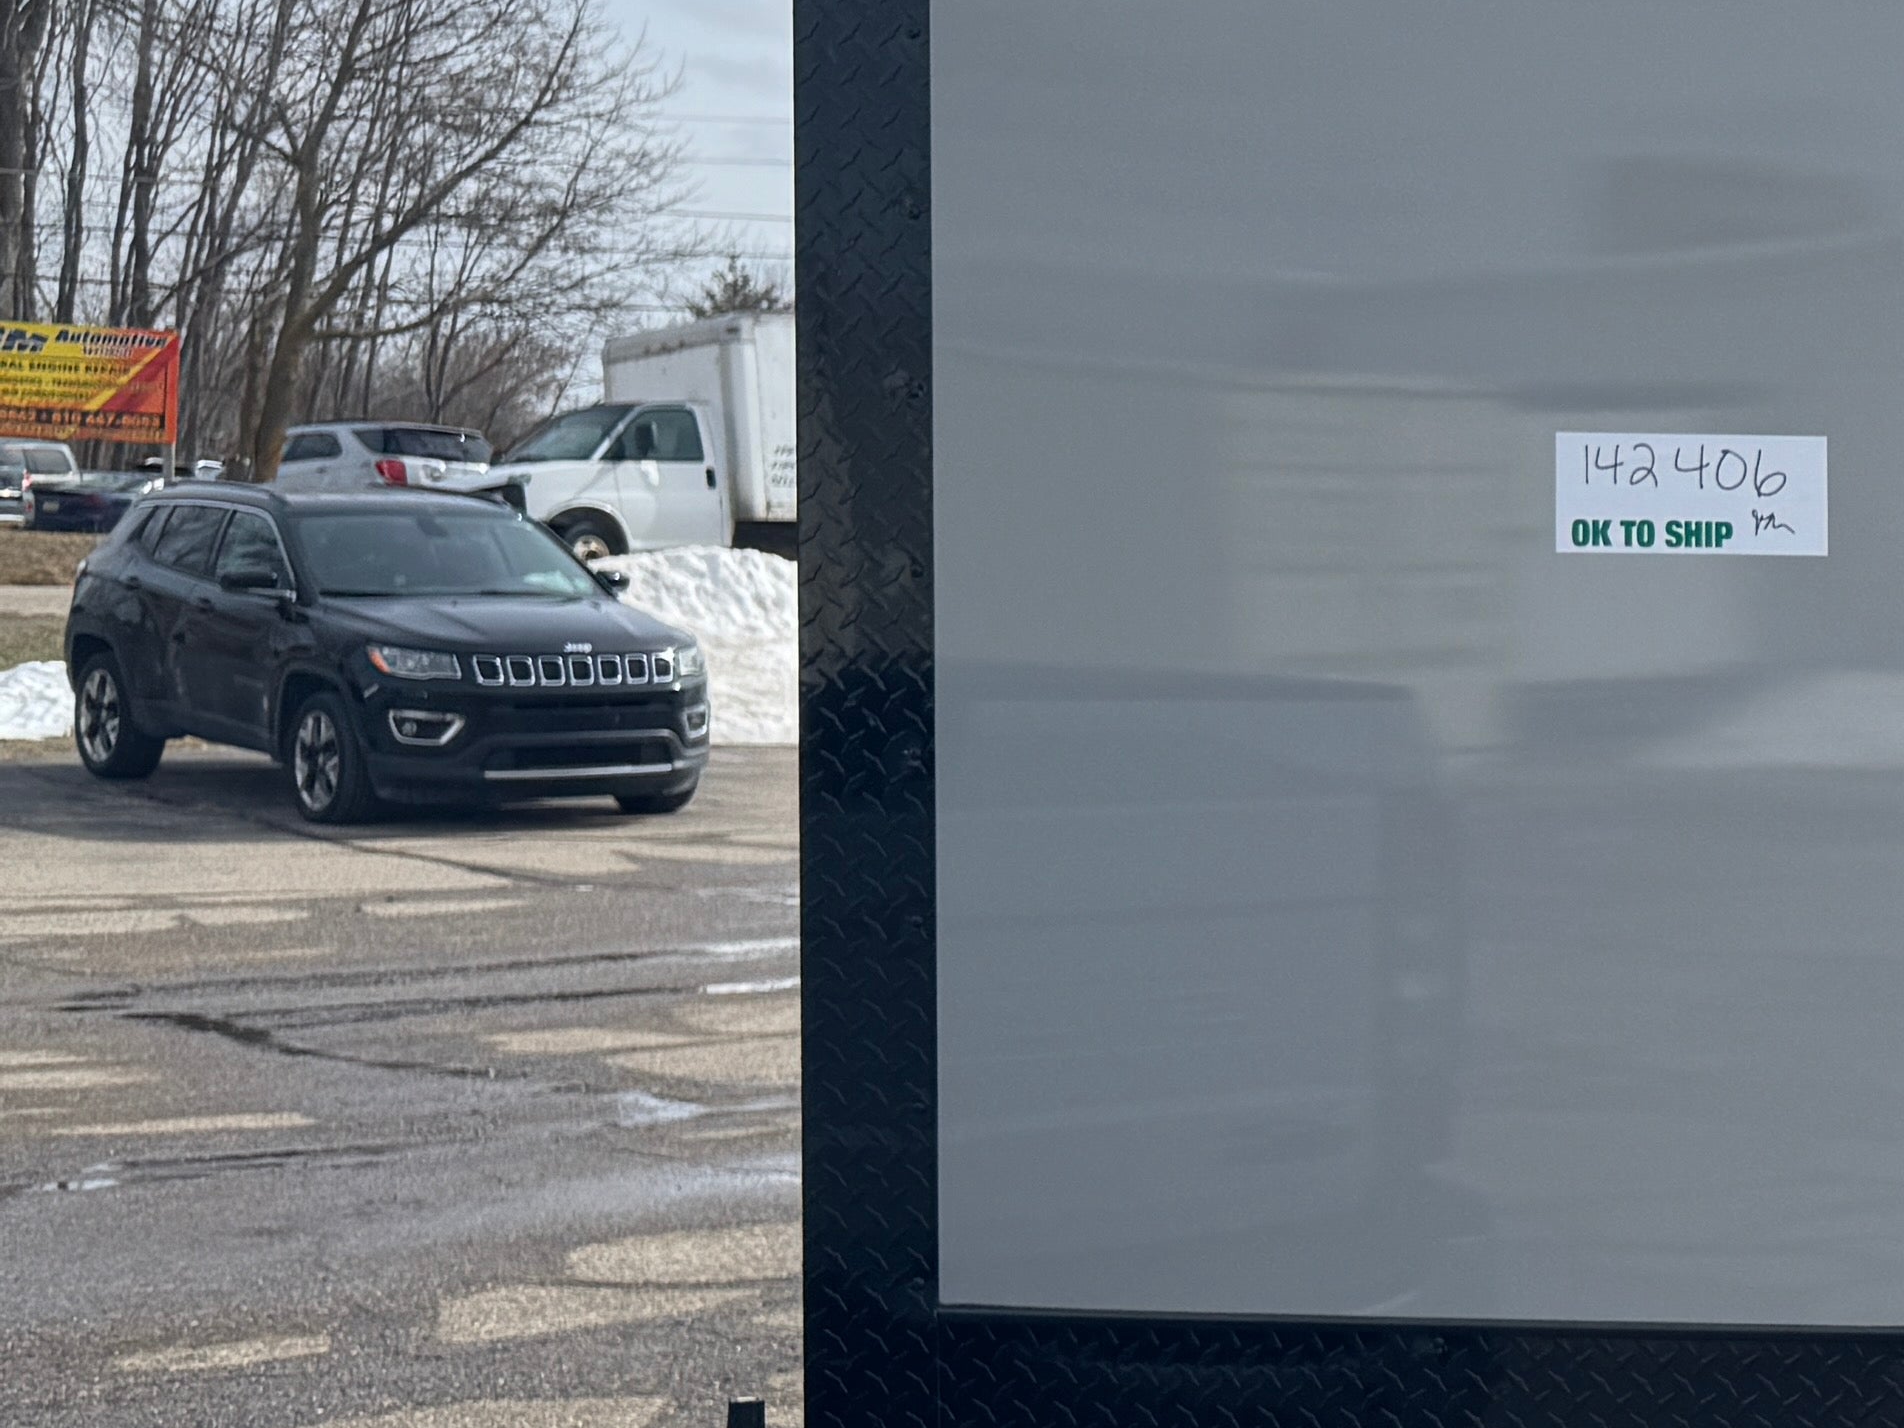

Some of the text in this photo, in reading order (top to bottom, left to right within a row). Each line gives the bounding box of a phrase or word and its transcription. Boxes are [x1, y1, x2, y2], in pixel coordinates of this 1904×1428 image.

[1571, 519, 1733, 548] OK TO SHIP
